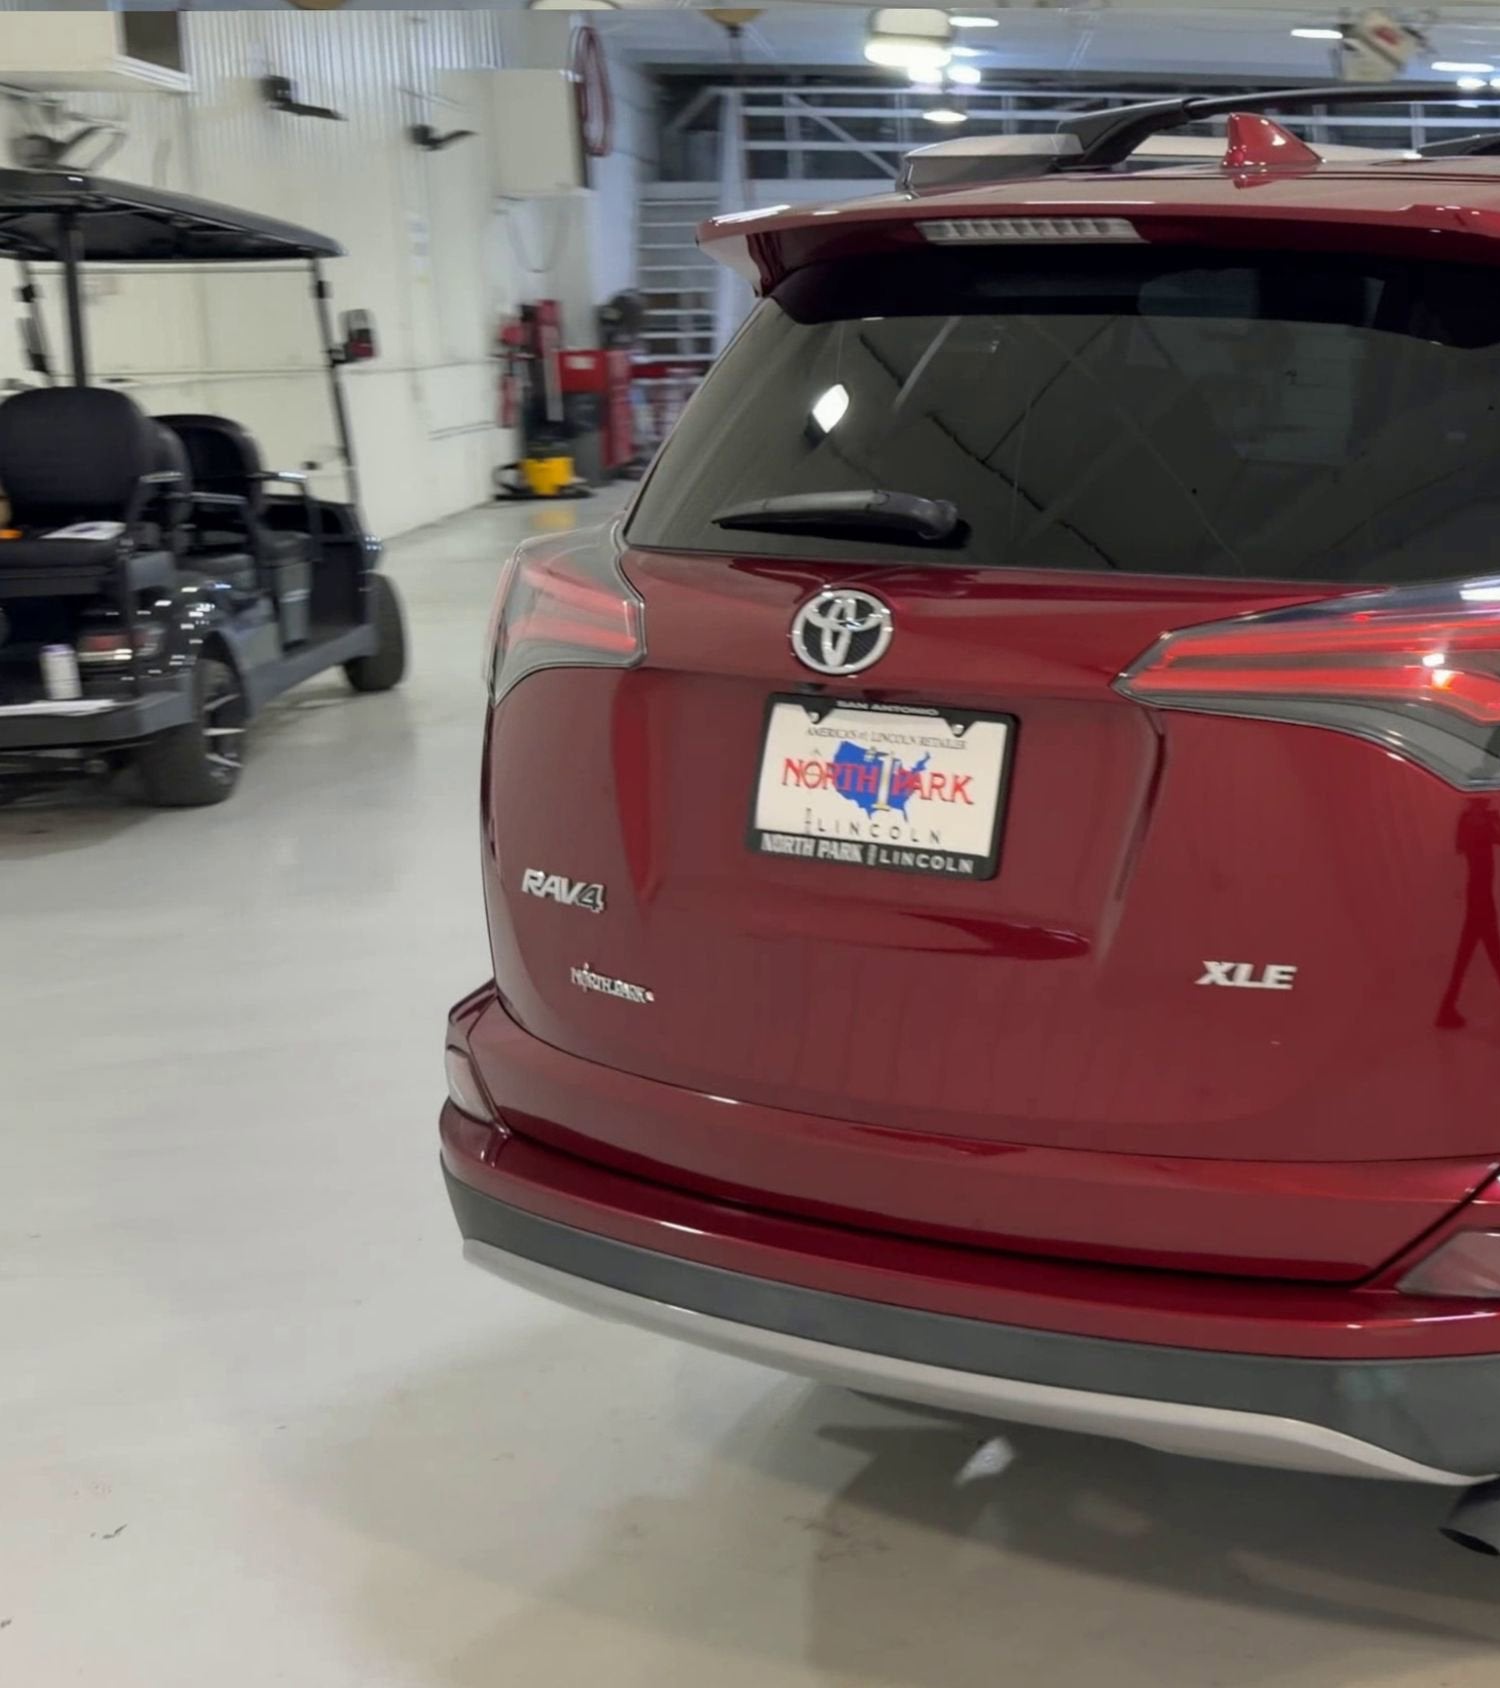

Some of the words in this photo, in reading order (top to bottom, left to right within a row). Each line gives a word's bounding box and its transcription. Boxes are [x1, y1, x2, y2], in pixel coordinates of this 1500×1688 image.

[781, 758, 880, 795] NORTH
[891, 766, 975, 806] PARK
[817, 818, 942, 845] LINCOLN
[760, 833, 816, 857] NORTH
[816, 839, 864, 863] PARK
[879, 850, 974, 874] LINCOLN
[521, 868, 605, 913] RAV4
[1194, 960, 1298, 990] XLE
